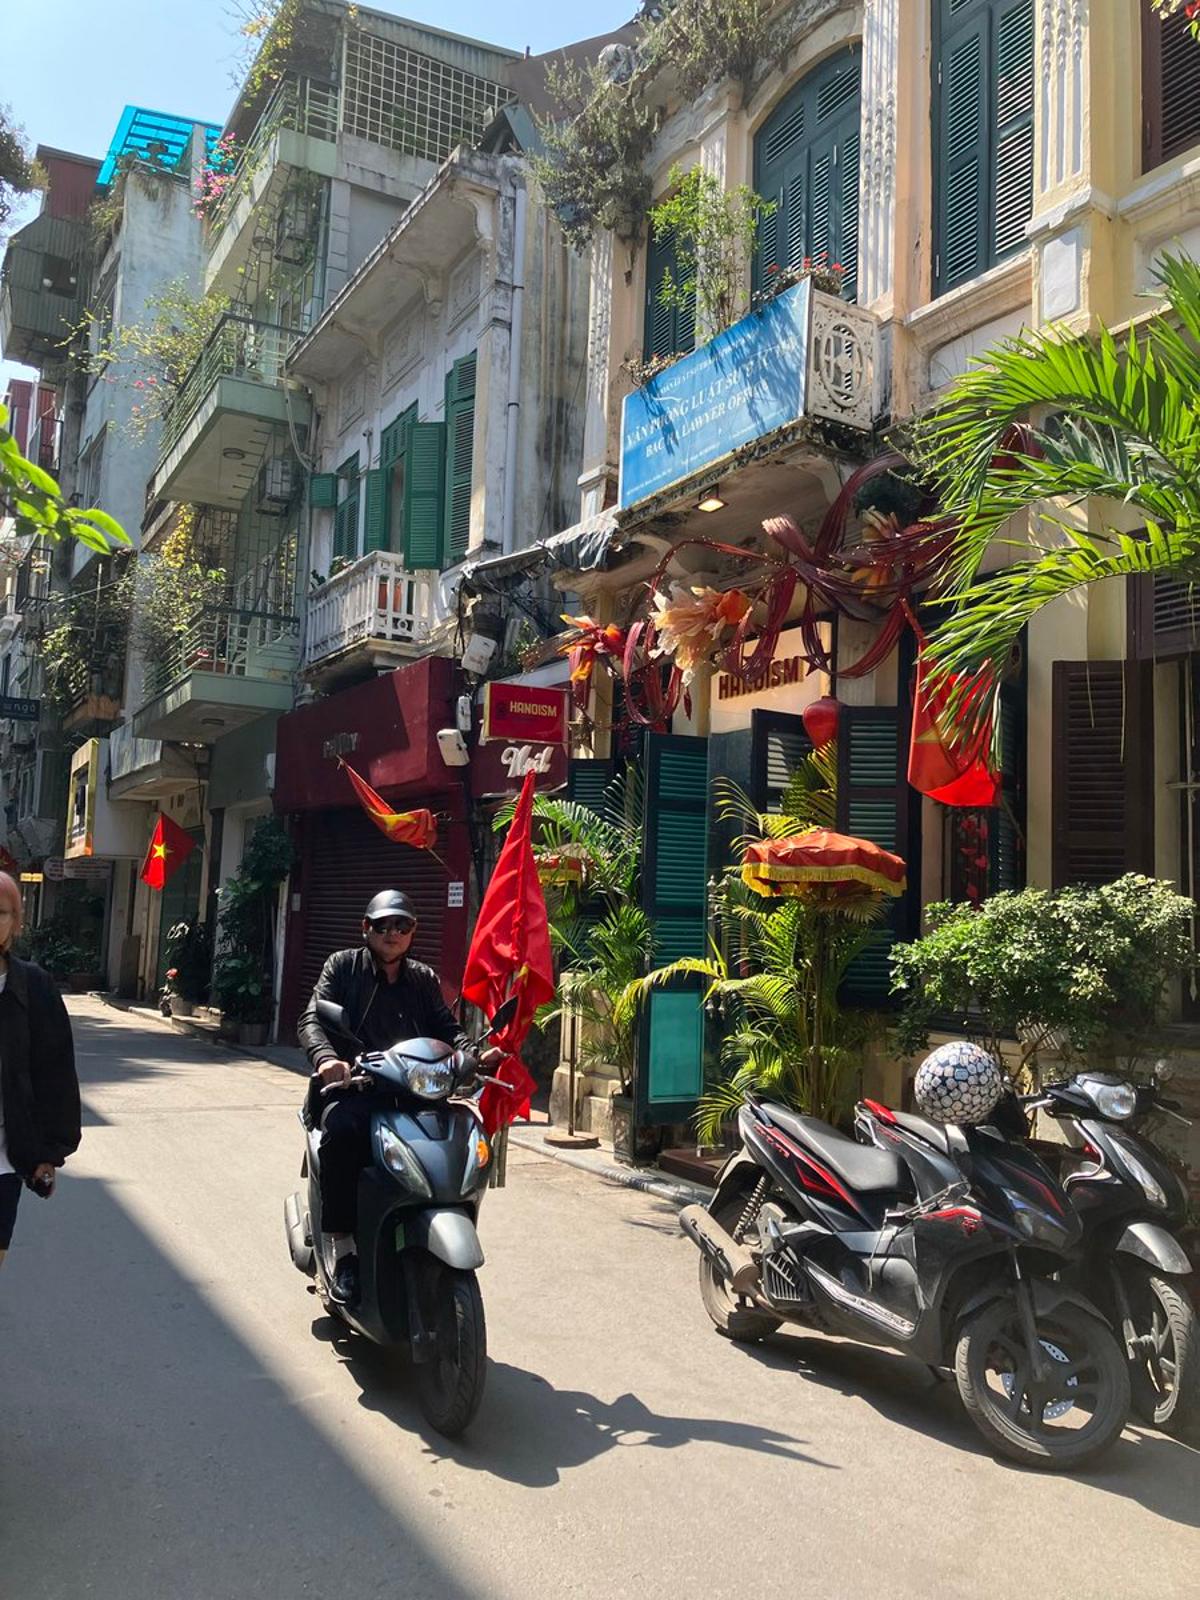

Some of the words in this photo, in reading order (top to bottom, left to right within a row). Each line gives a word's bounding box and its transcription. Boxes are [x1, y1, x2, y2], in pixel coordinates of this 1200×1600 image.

[691, 379, 724, 410] LUẬT
[681, 402, 726, 437] LAWYER
[509, 700, 557, 718] HANOISM
